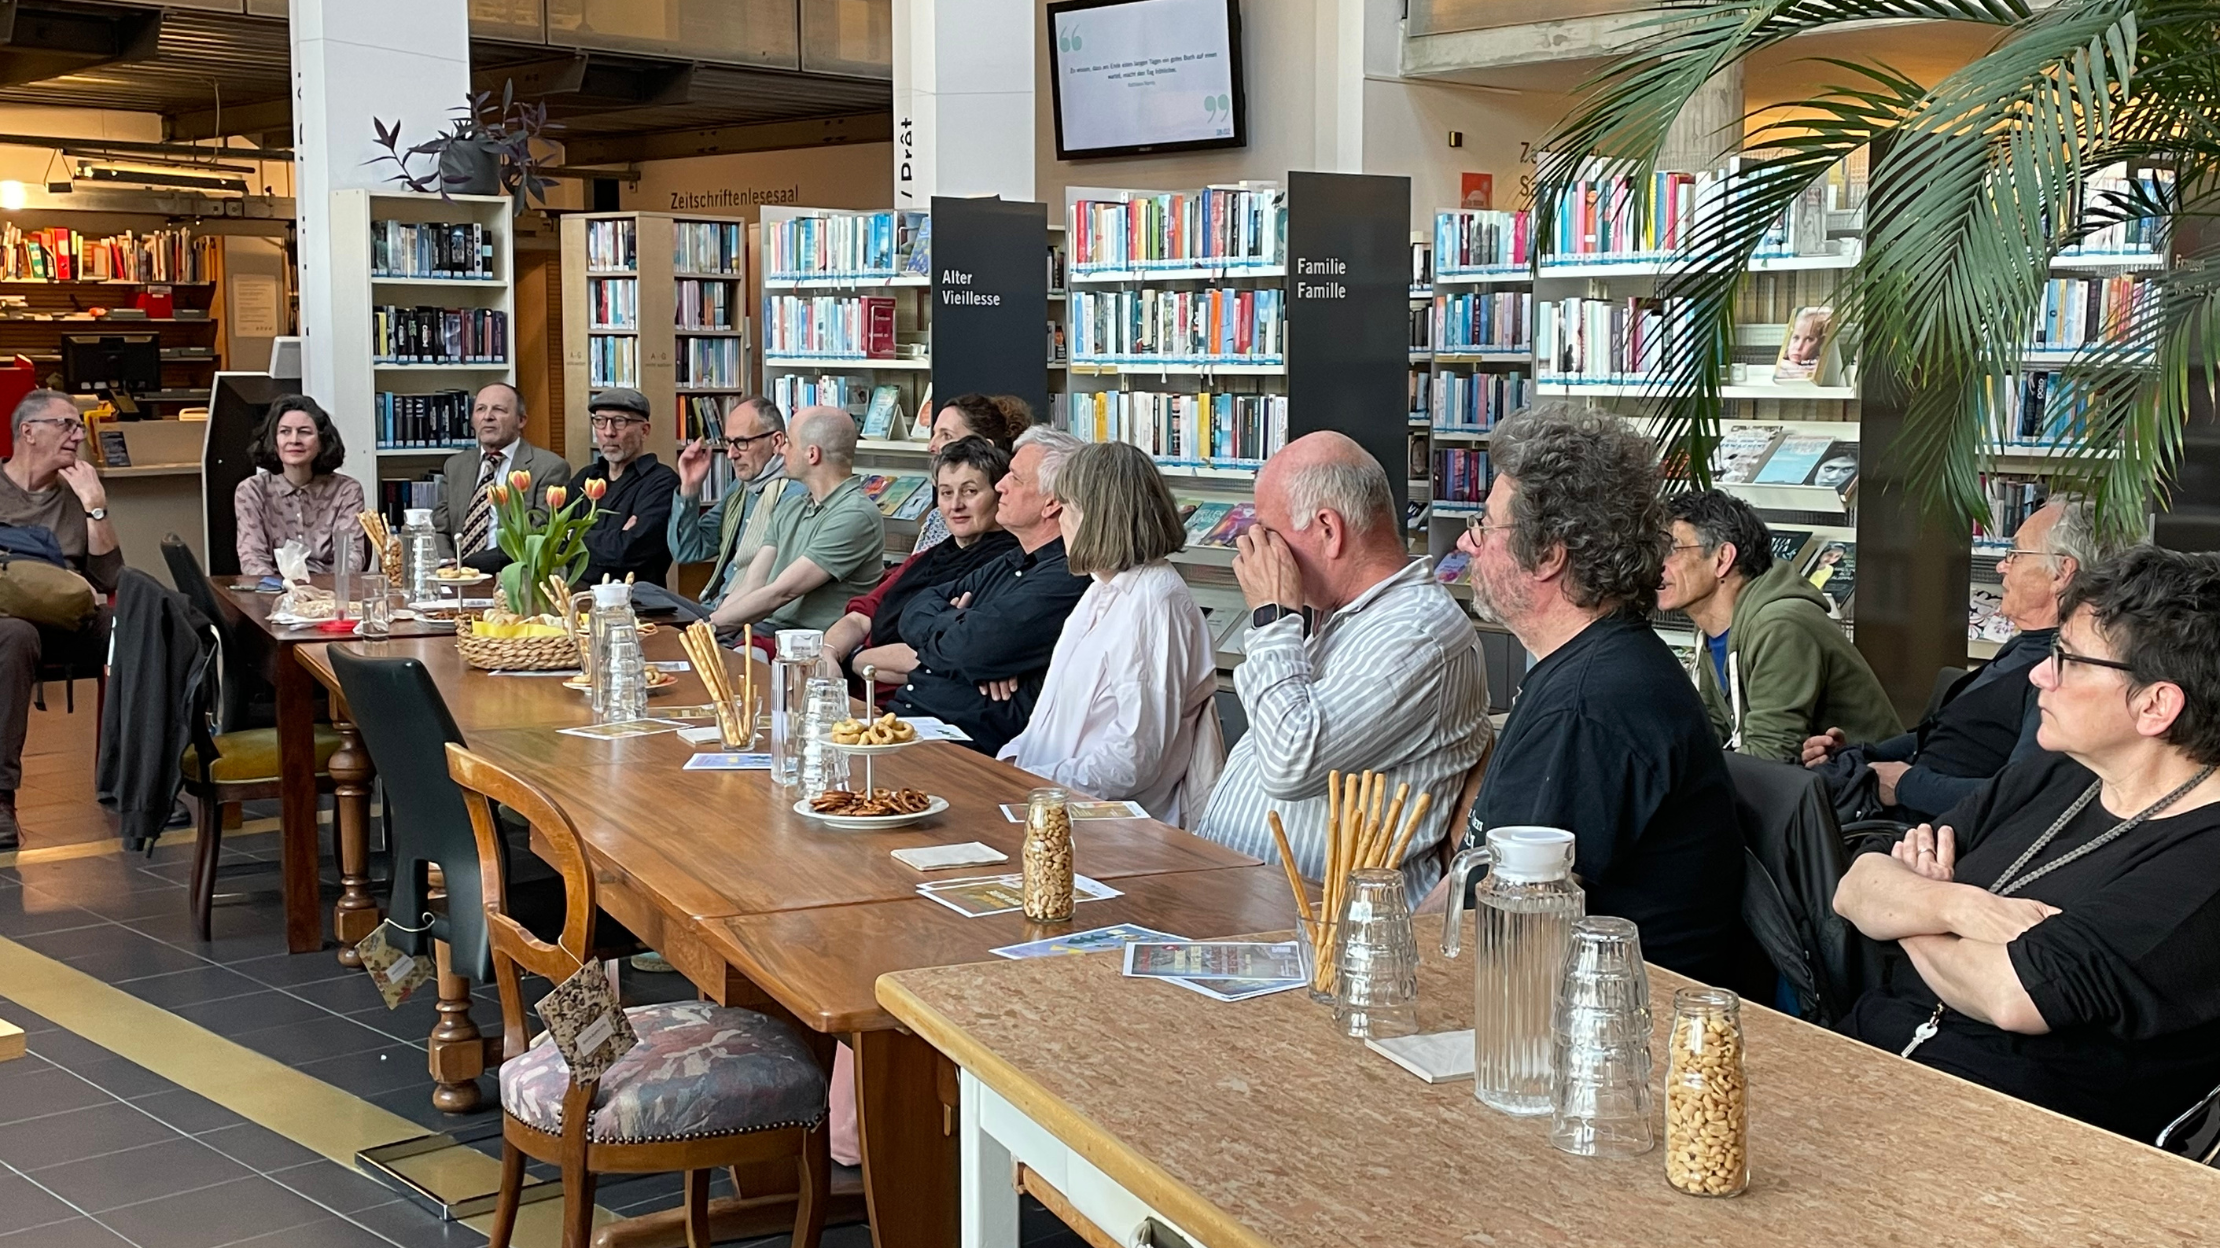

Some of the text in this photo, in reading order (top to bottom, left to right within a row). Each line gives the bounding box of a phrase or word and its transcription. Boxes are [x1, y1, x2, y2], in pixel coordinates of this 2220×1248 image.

[670, 184, 799, 210] Zeitschriftenlesesaal
[1297, 257, 1347, 275] Familie
[941, 269, 973, 285] Alter
[941, 289, 1001, 306] Vieillesse
[1297, 281, 1347, 299] Famille
